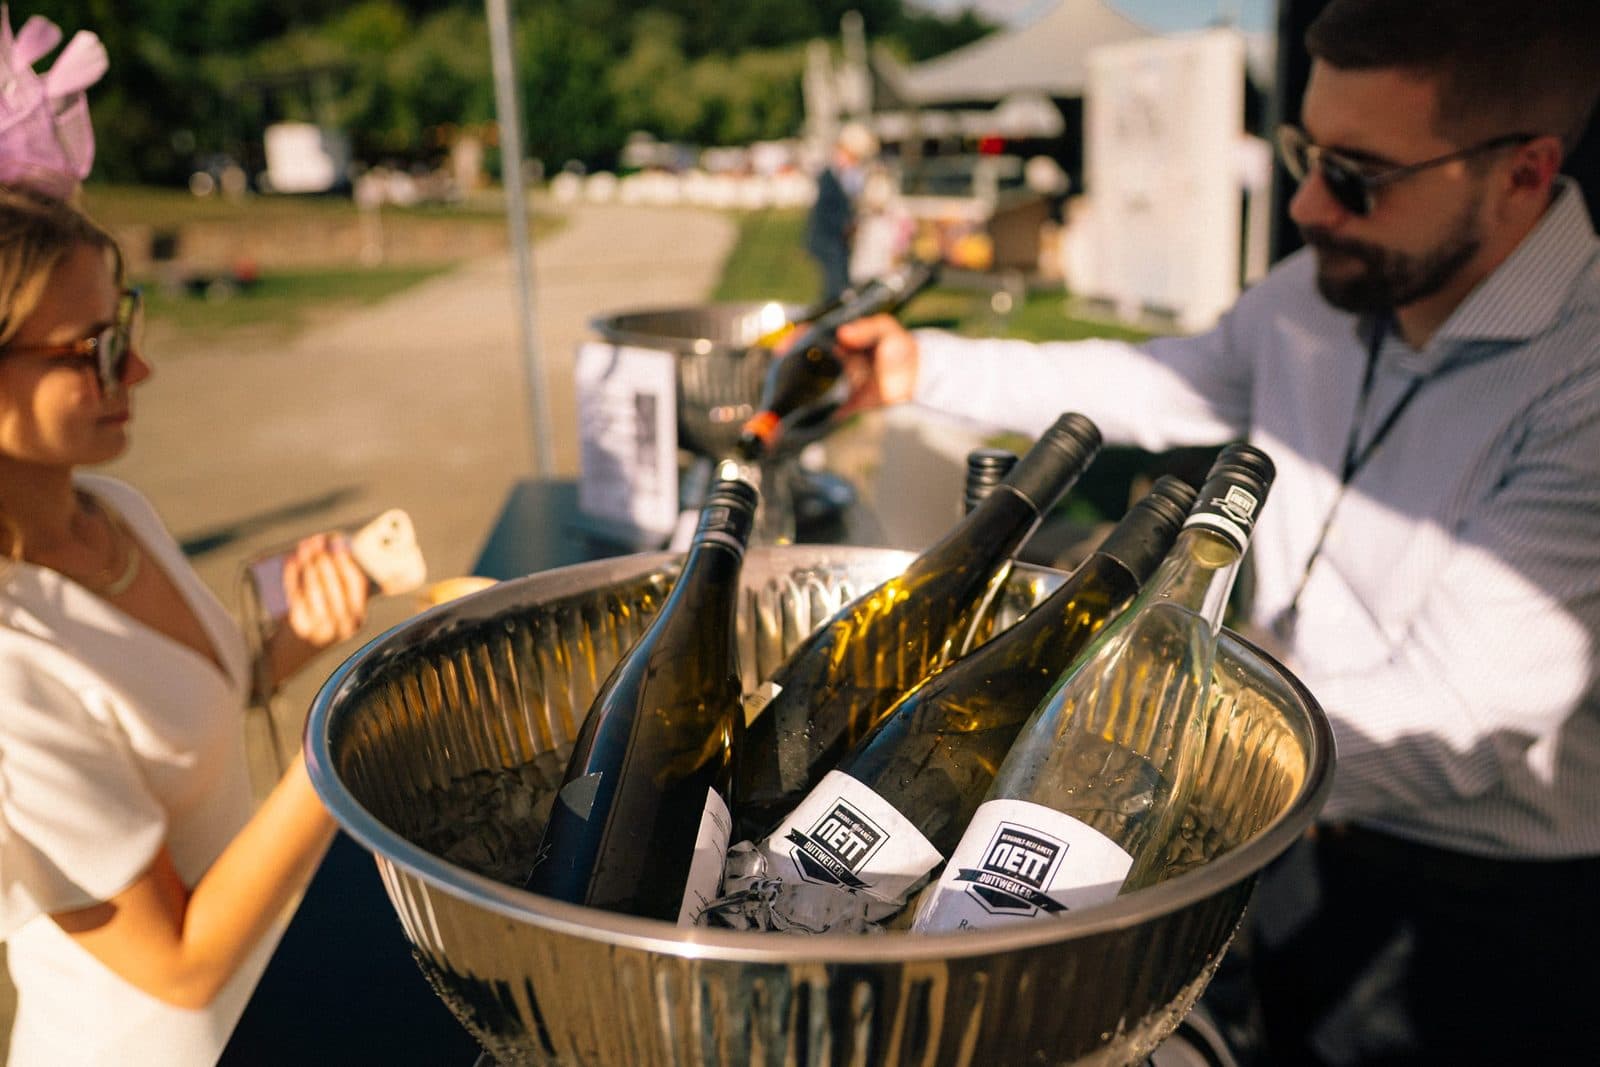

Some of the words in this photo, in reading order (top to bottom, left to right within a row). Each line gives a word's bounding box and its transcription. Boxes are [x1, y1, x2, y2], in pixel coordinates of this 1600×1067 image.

[816, 818, 868, 861] NETT
[803, 840, 844, 877] DUTTWEILER
[988, 843, 1051, 880] NETT
[978, 873, 1033, 899] DUTTWEILER
